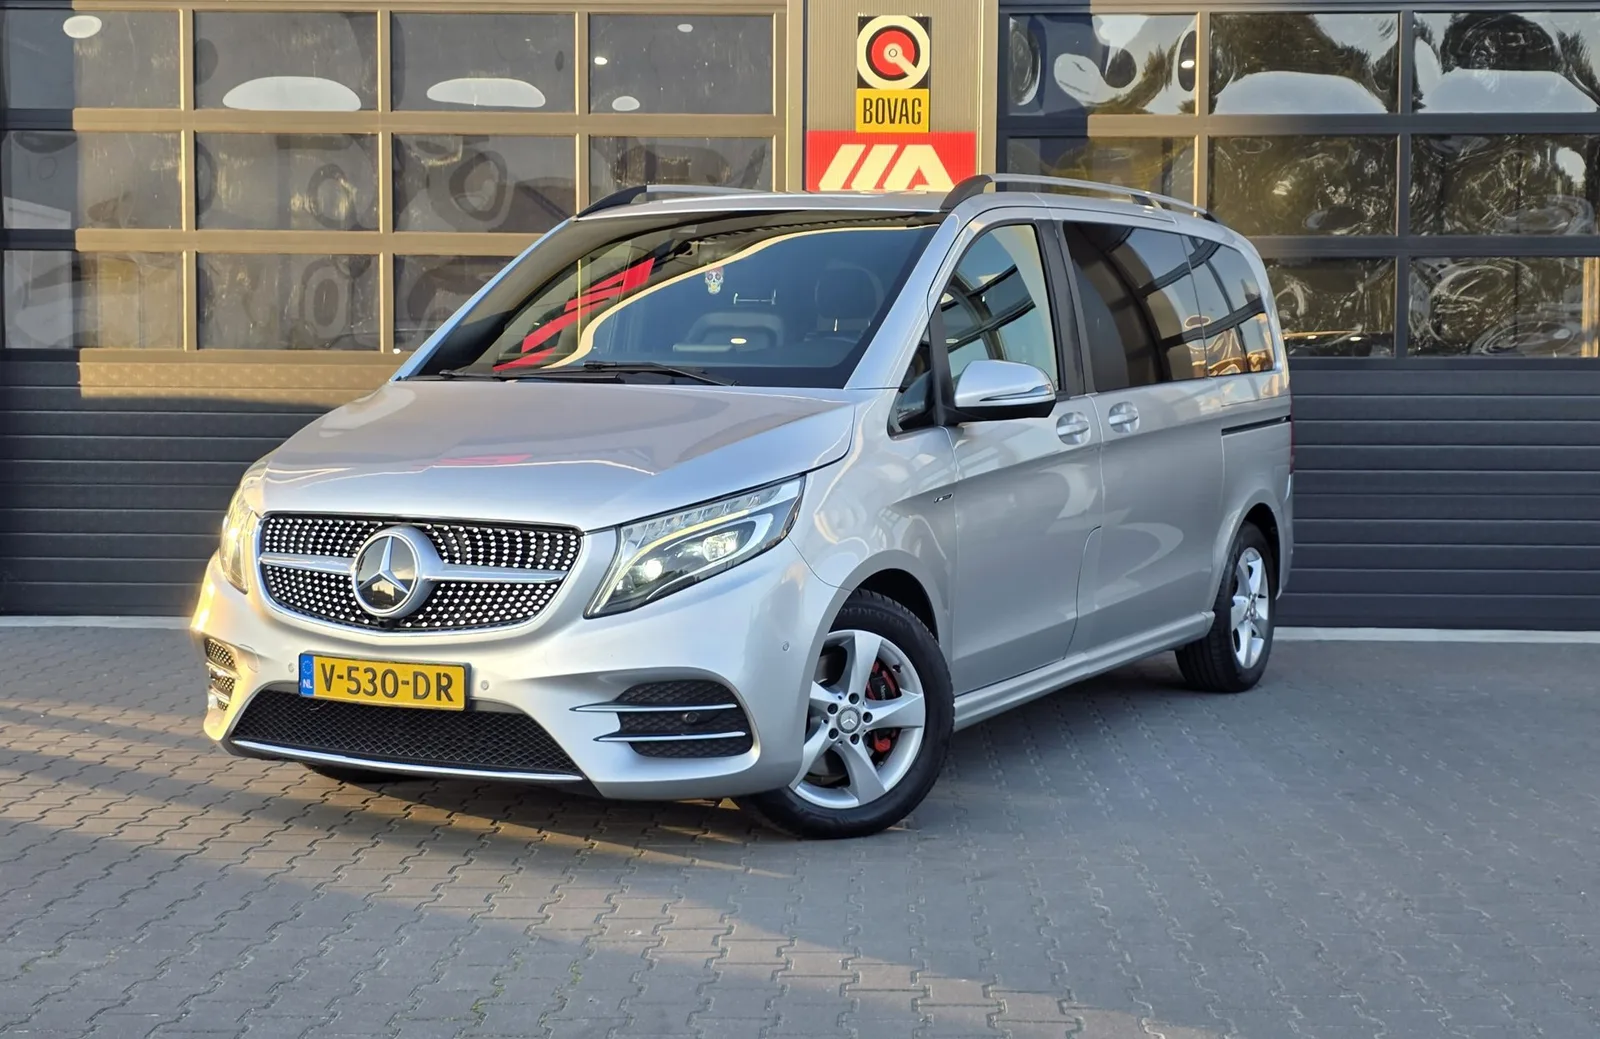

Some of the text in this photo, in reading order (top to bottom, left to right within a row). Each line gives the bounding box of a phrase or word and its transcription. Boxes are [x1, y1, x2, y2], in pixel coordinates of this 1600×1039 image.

[863, 97, 922, 125] BOVAG
[302, 678, 313, 689] NL
[321, 663, 454, 702] V-530-DR
